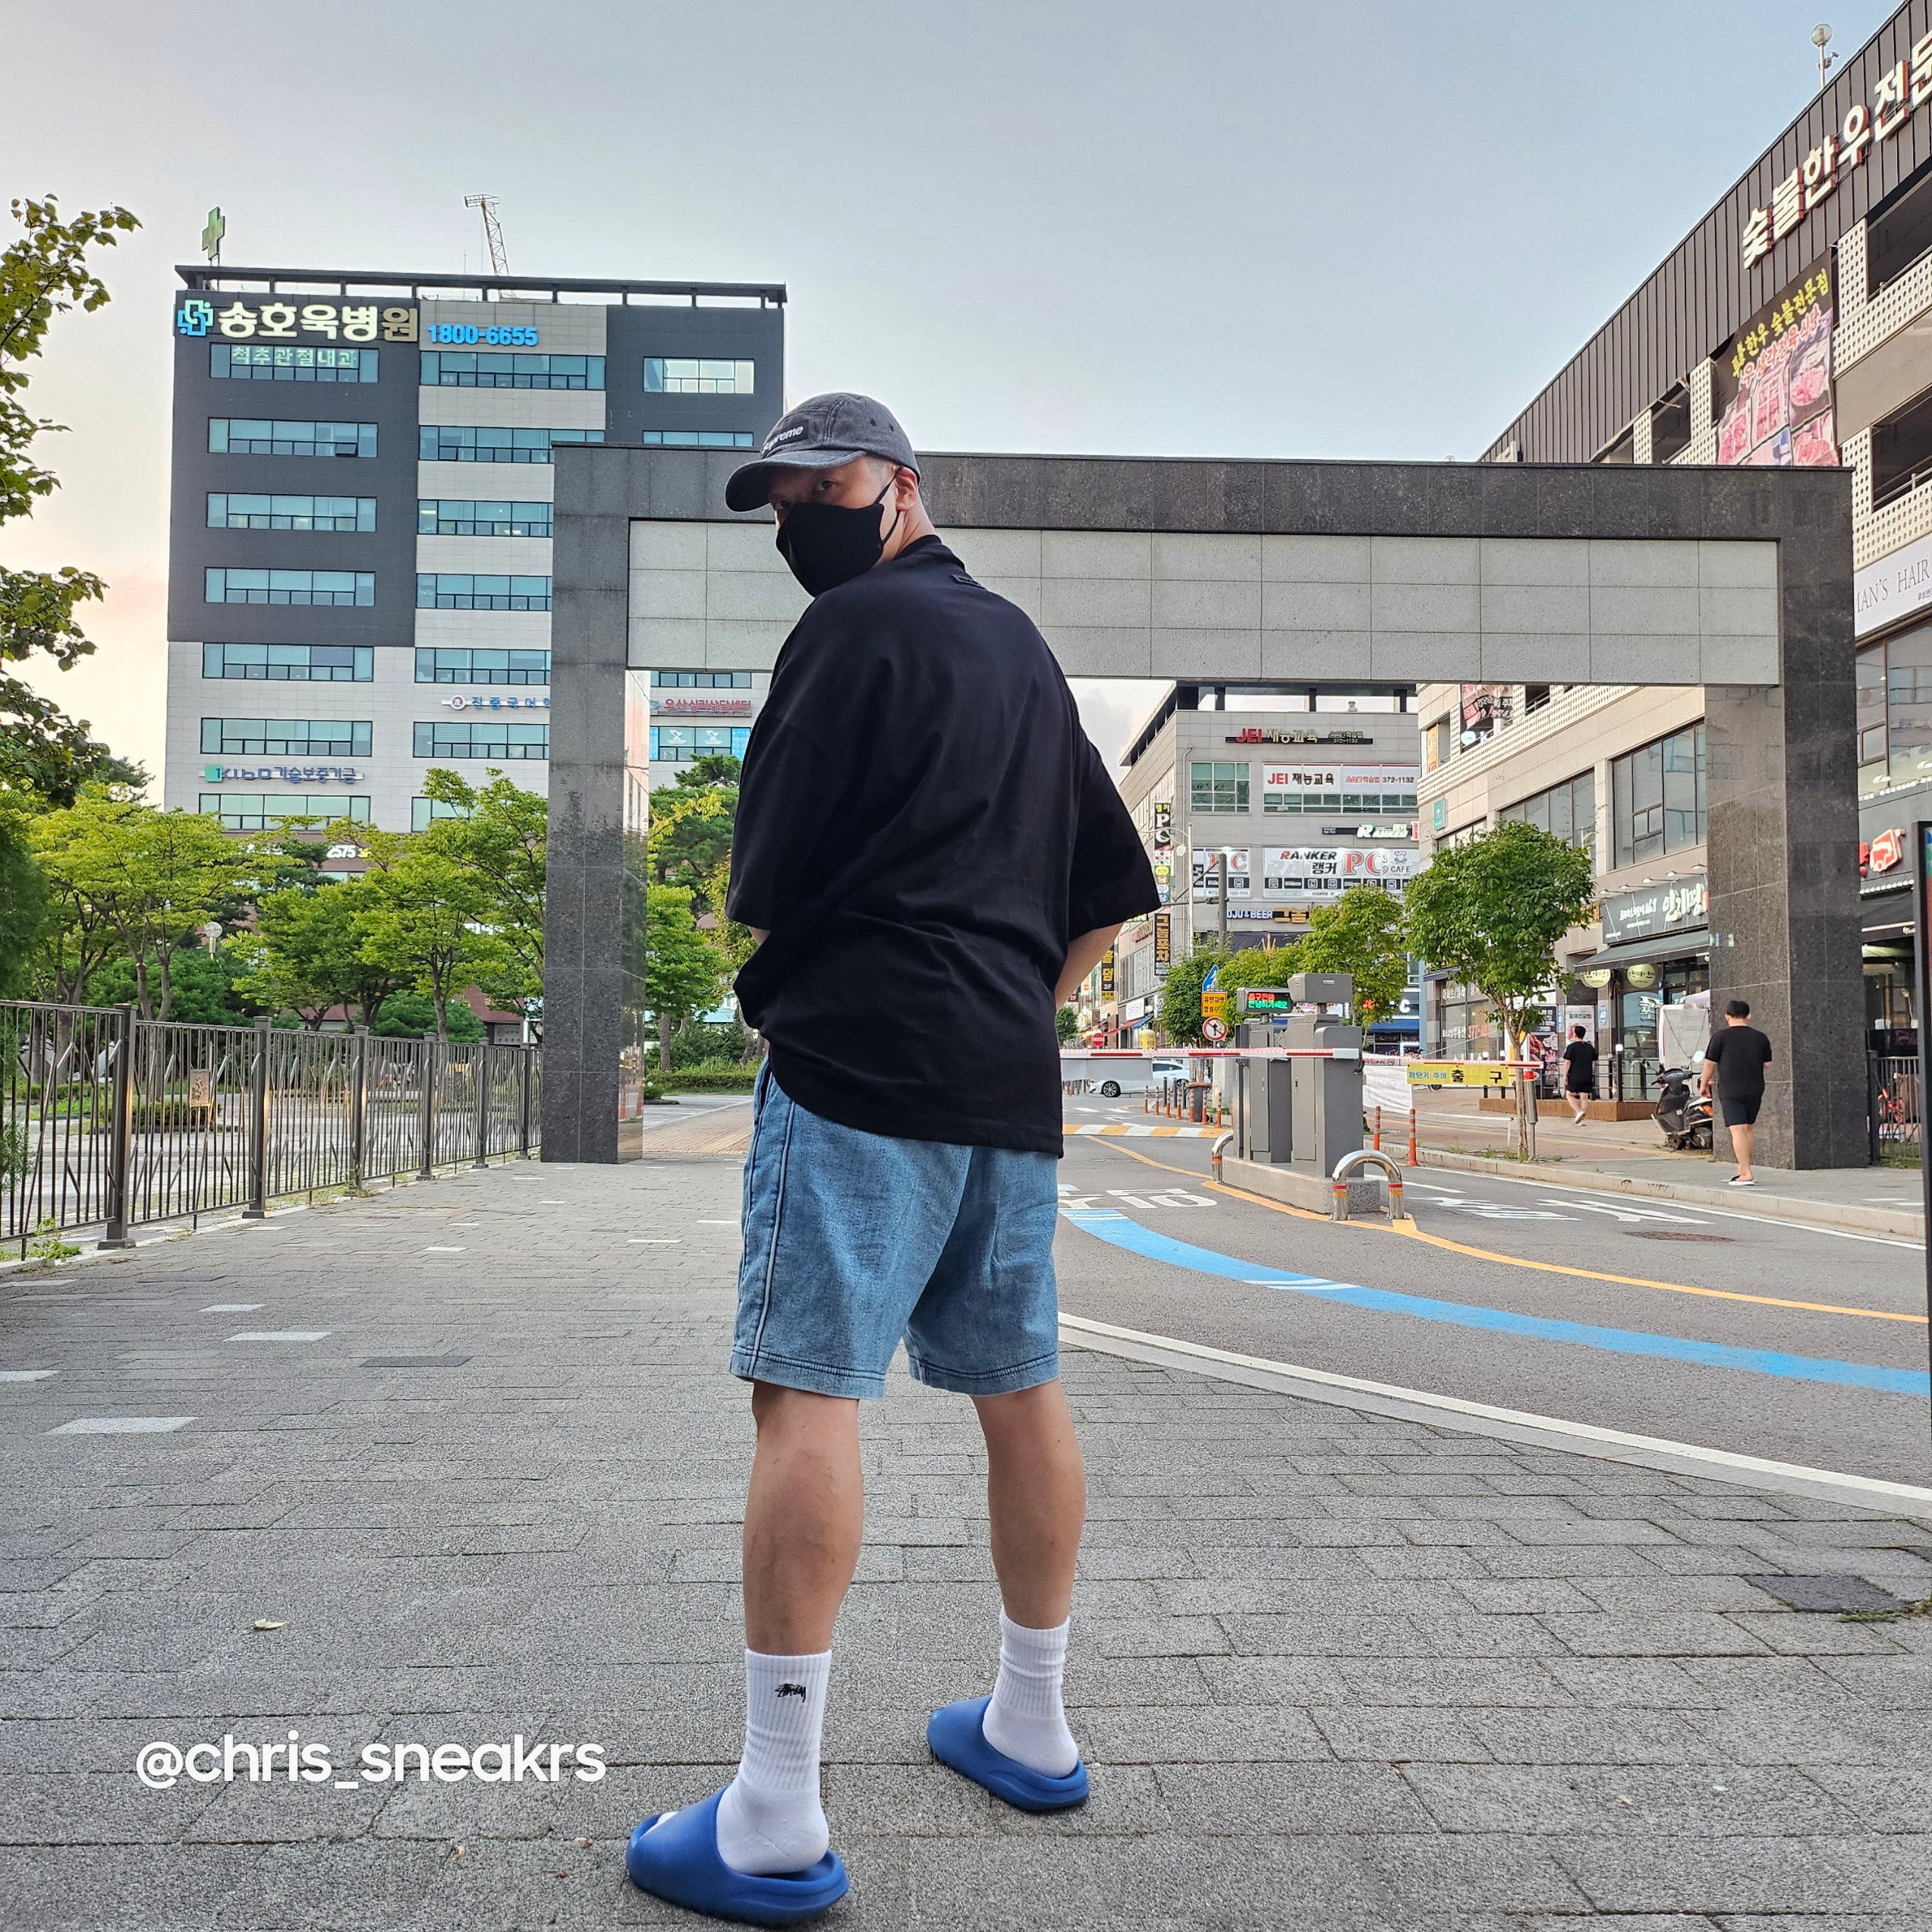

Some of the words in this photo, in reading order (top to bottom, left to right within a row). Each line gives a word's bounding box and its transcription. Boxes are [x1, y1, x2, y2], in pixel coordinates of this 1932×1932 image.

[1771, 268, 1829, 336] 숯불전문점
[218, 300, 417, 342] 송호욱병원
[428, 324, 538, 346] 1800-6655
[232, 346, 357, 369] 척추관절내과
[1897, 559, 1930, 593] HAIR
[1235, 728, 1263, 743] JEI
[1266, 728, 1318, 744] 재능교육
[274, 766, 356, 785] 기술보증기금
[1267, 773, 1289, 785] JEI
[1292, 772, 1334, 785] 재능교육
[1280, 851, 1337, 861] RANKER
[1342, 851, 1388, 876] PC
[1312, 862, 1338, 874] 랭커
[1227, 909, 1273, 918] OJU&BEER
[1248, 1000, 1288, 1009] 안녕히가세요
